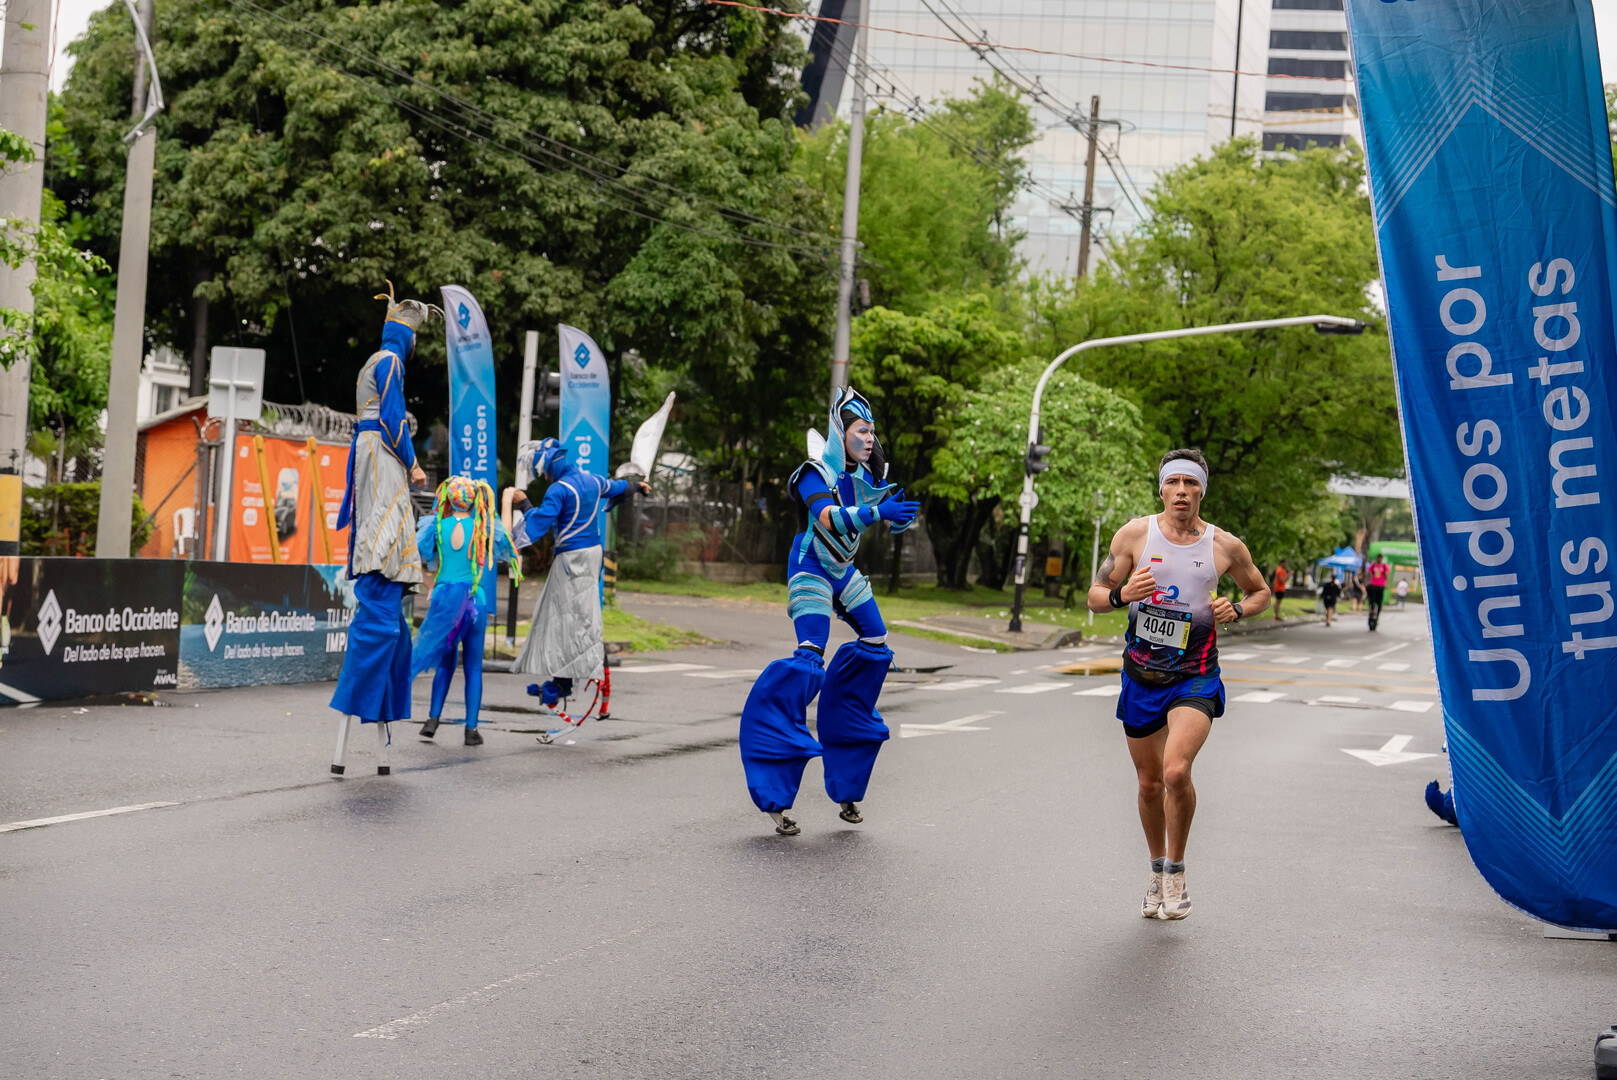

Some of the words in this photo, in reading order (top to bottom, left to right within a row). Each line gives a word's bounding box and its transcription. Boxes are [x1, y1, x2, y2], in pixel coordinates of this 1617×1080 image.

[1434, 254, 1514, 391] por
[1528, 258, 1600, 508] metas
[461, 424, 472, 451] de
[474, 405, 488, 471] hacen
[575, 435, 592, 474] rte!
[460, 457, 471, 480] do
[1445, 419, 1531, 701] Unidos
[1561, 537, 1617, 660] tus
[65, 608, 104, 634] Banco
[105, 607, 121, 632] de
[122, 606, 179, 631] Occidente
[226, 611, 256, 634] Banco
[257, 610, 270, 633] de
[271, 610, 315, 632] Occidente
[327, 608, 340, 628] TU
[1143, 616, 1175, 637] 4040
[63, 644, 79, 663] Del
[79, 644, 98, 662] lado
[99, 643, 110, 660] de
[111, 642, 123, 660] los
[124, 647, 140, 662] que
[224, 644, 236, 659] Del
[237, 643, 252, 659] lado
[252, 643, 260, 658] de
[261, 642, 271, 658] los
[272, 647, 284, 660] que
[326, 632, 349, 652] IMP
[154, 674, 177, 685] AVAL
